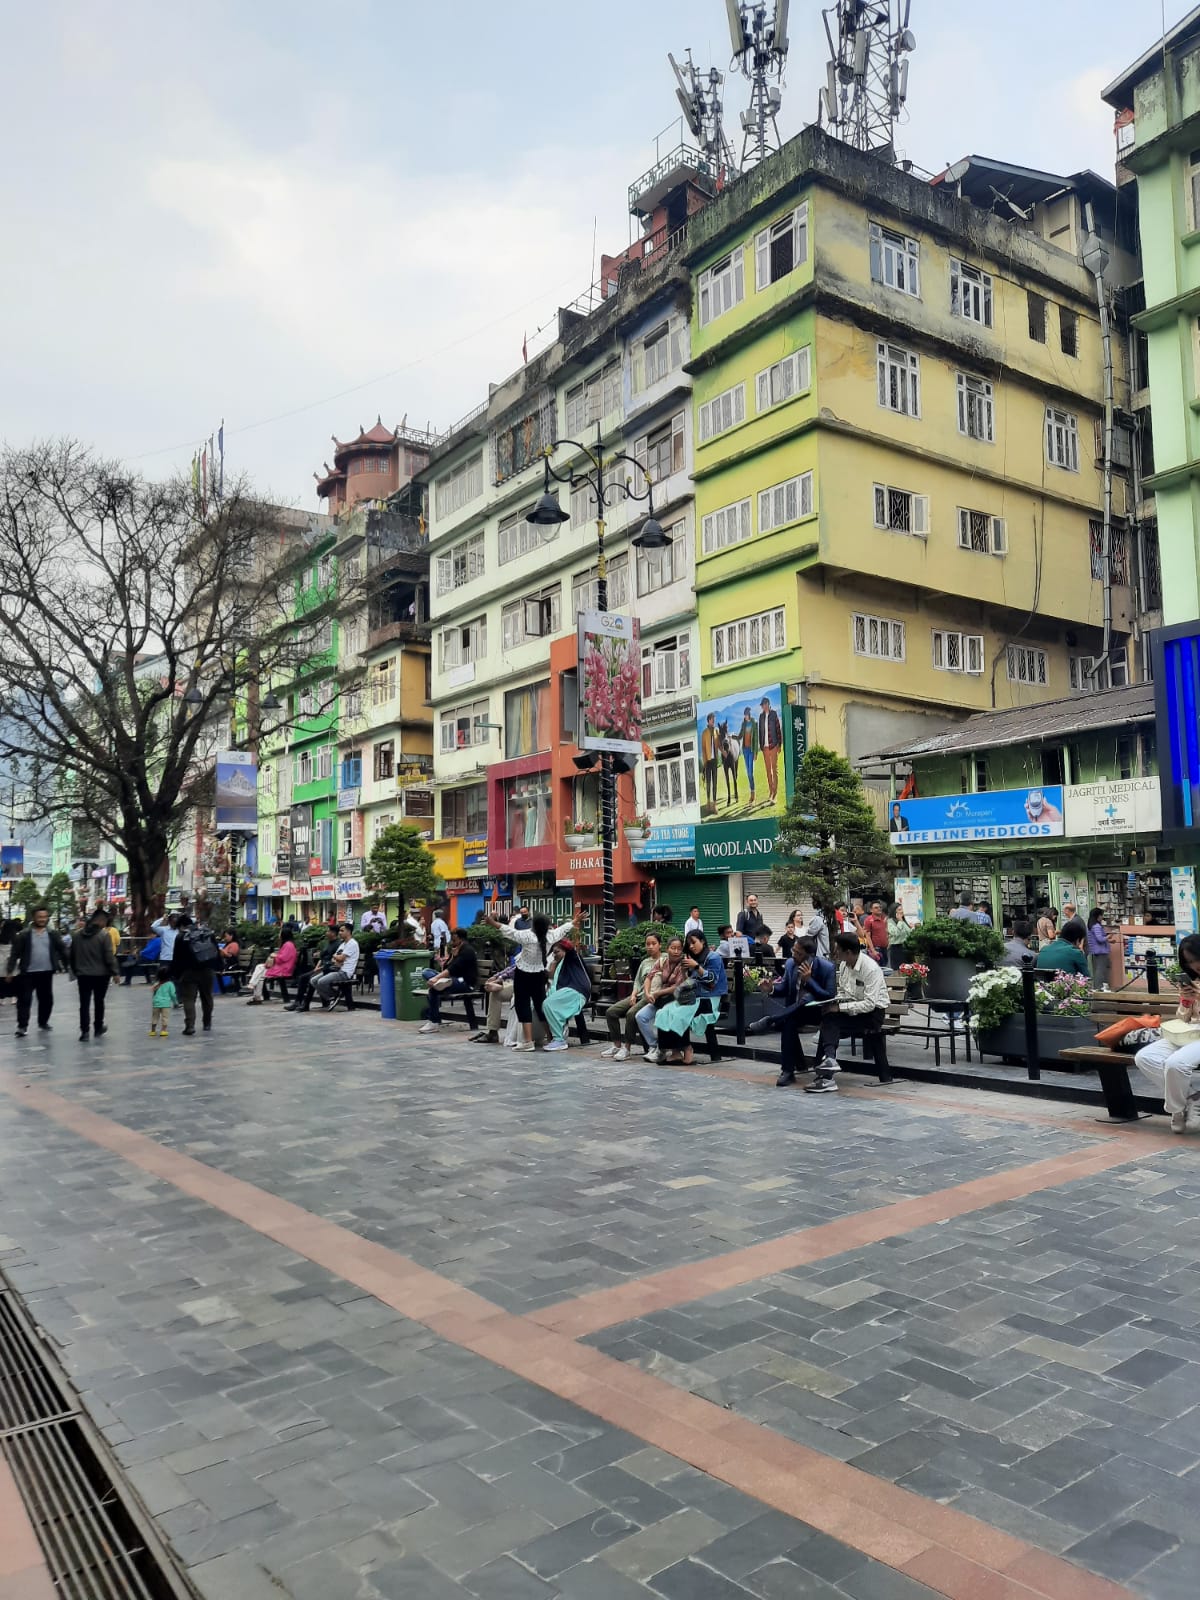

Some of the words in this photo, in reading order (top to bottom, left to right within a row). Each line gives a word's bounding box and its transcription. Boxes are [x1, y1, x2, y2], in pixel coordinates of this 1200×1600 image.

[1068, 786, 1106, 798] JAGRITI
[1108, 780, 1156, 794] MEDICAL
[1093, 794, 1129, 805] STORES
[292, 826, 309, 844] THAI
[898, 831, 929, 843] LIFE
[934, 828, 969, 841] LINE
[974, 824, 1051, 838] MEDICOS
[295, 844, 305, 856] SPA
[702, 838, 773, 857] WOODLAND
